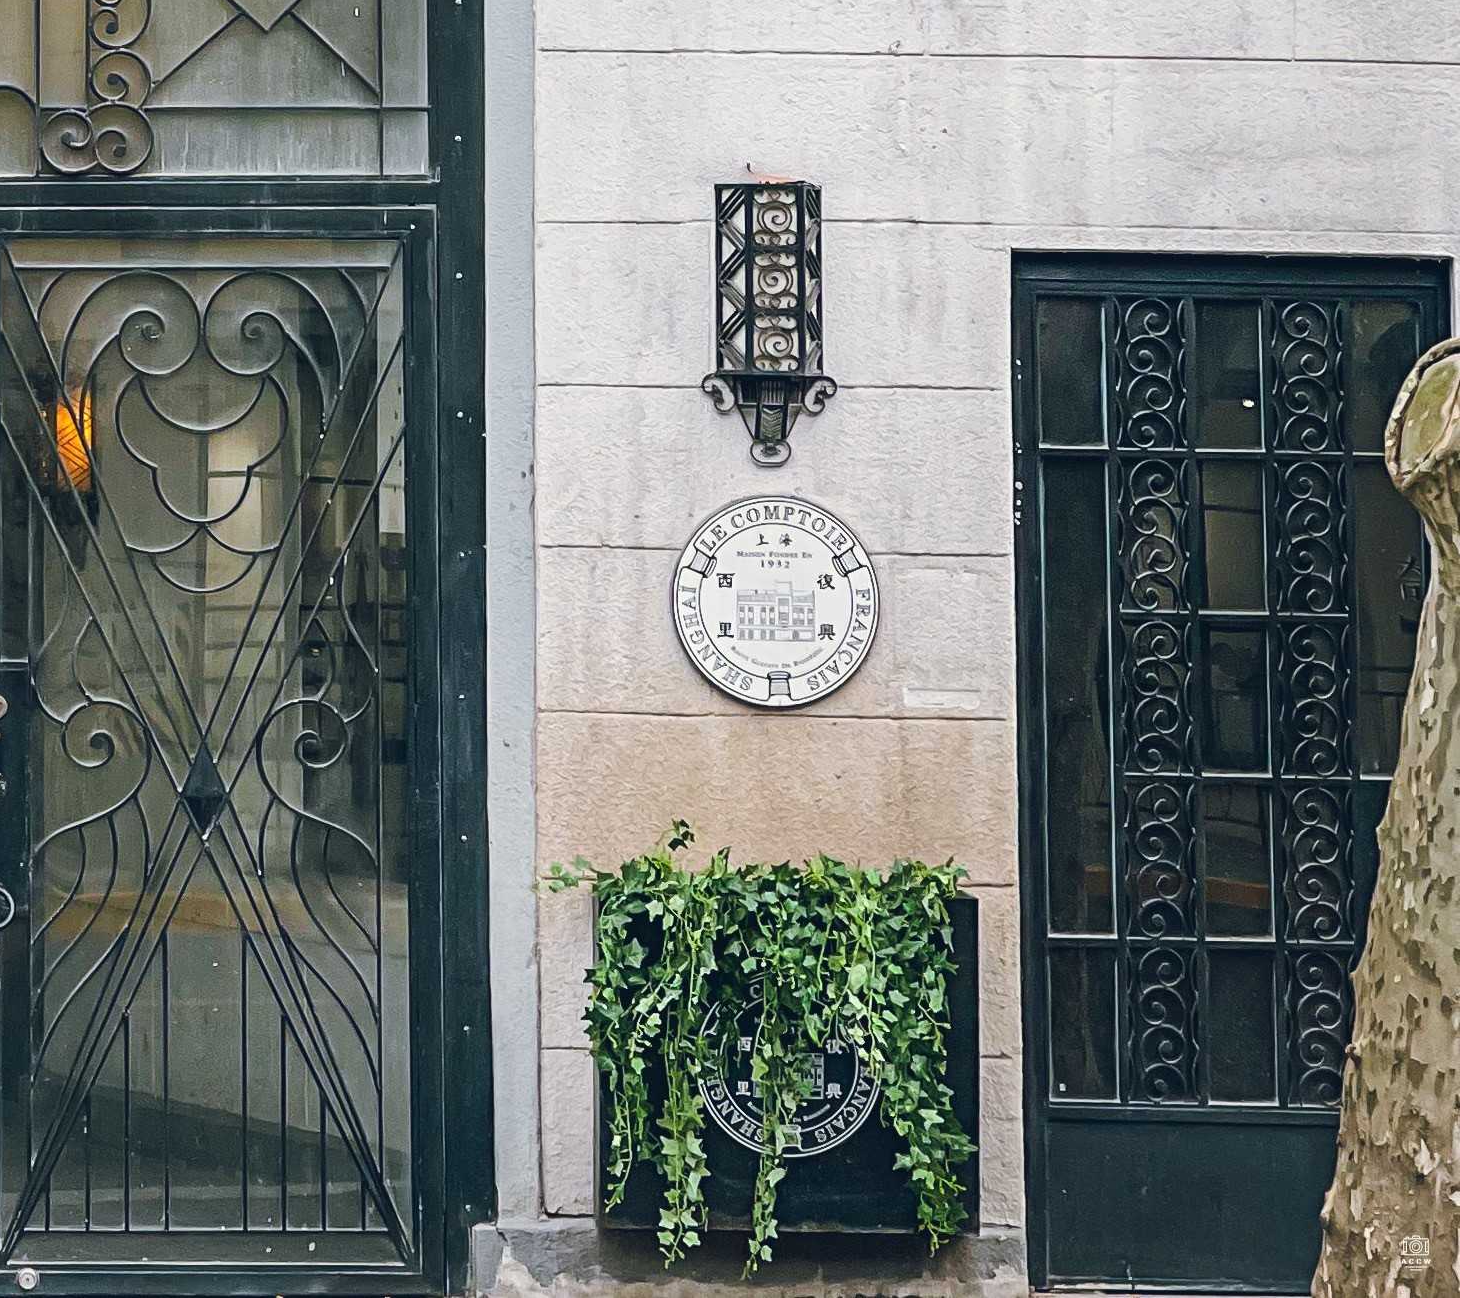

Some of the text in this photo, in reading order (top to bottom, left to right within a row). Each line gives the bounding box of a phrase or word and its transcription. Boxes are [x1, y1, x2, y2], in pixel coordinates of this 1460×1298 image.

[680, 586, 754, 691] SHANGHAI
[699, 524, 728, 552] LE
[730, 505, 849, 552] COMPTOIR
[806, 588, 871, 692] FRANÇAIS
